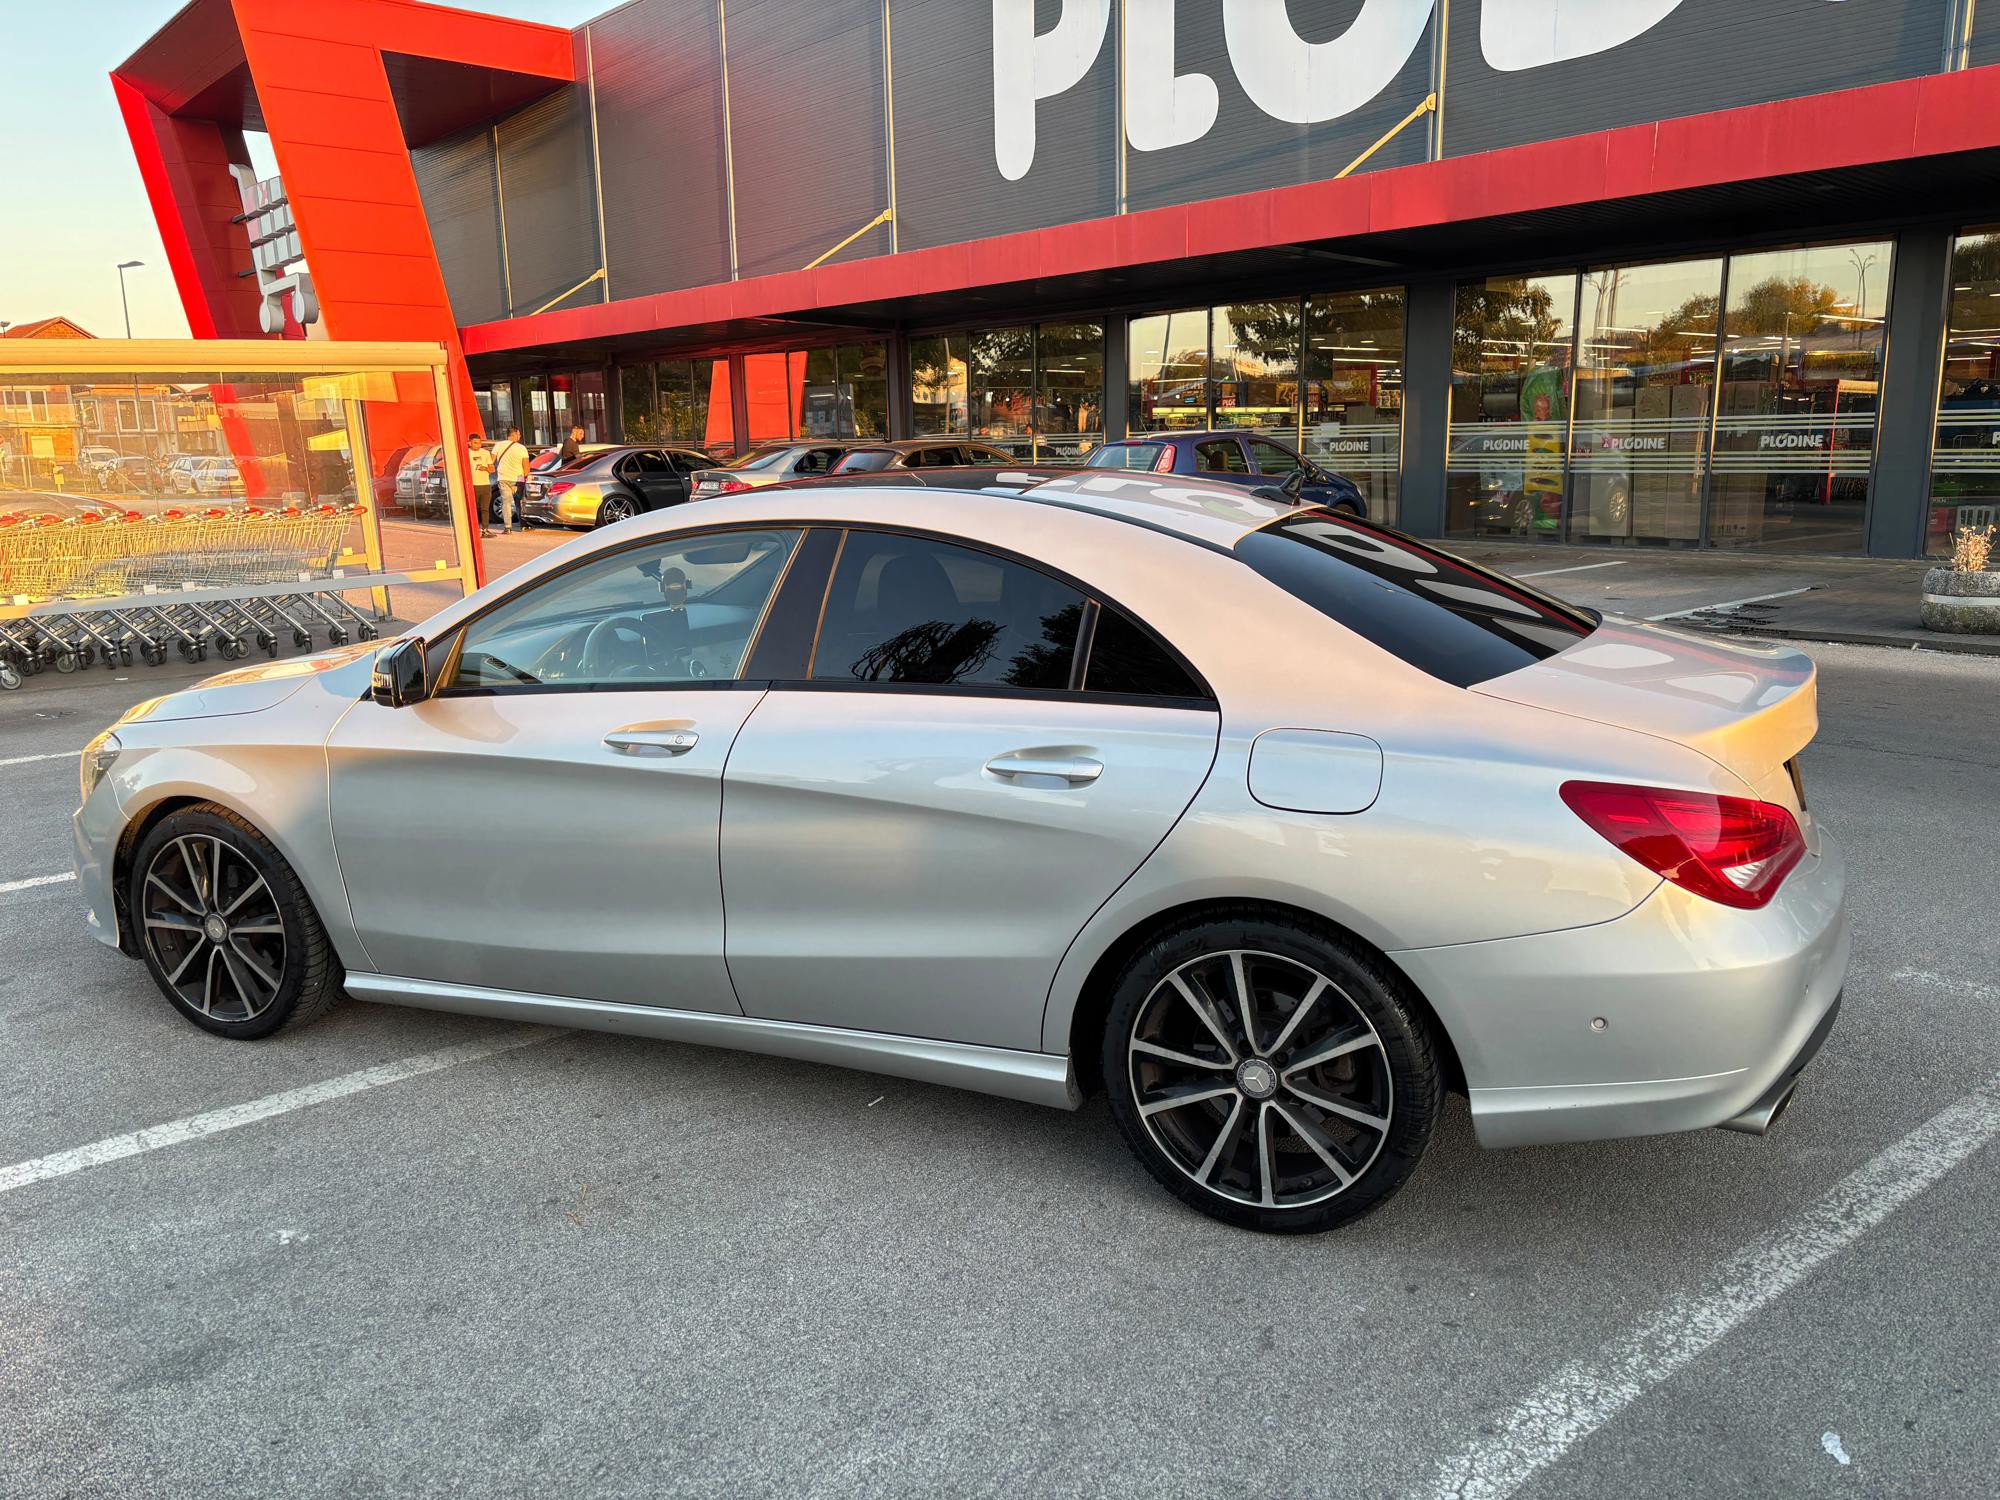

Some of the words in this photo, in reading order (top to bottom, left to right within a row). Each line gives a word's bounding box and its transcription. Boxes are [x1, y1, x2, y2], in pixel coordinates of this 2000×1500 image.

[1329, 440, 1369, 452] PLODINE
[1483, 438, 1531, 451] PLODINE
[1611, 437, 1666, 450] PLODINE
[1761, 433, 1824, 448] PLODINE
